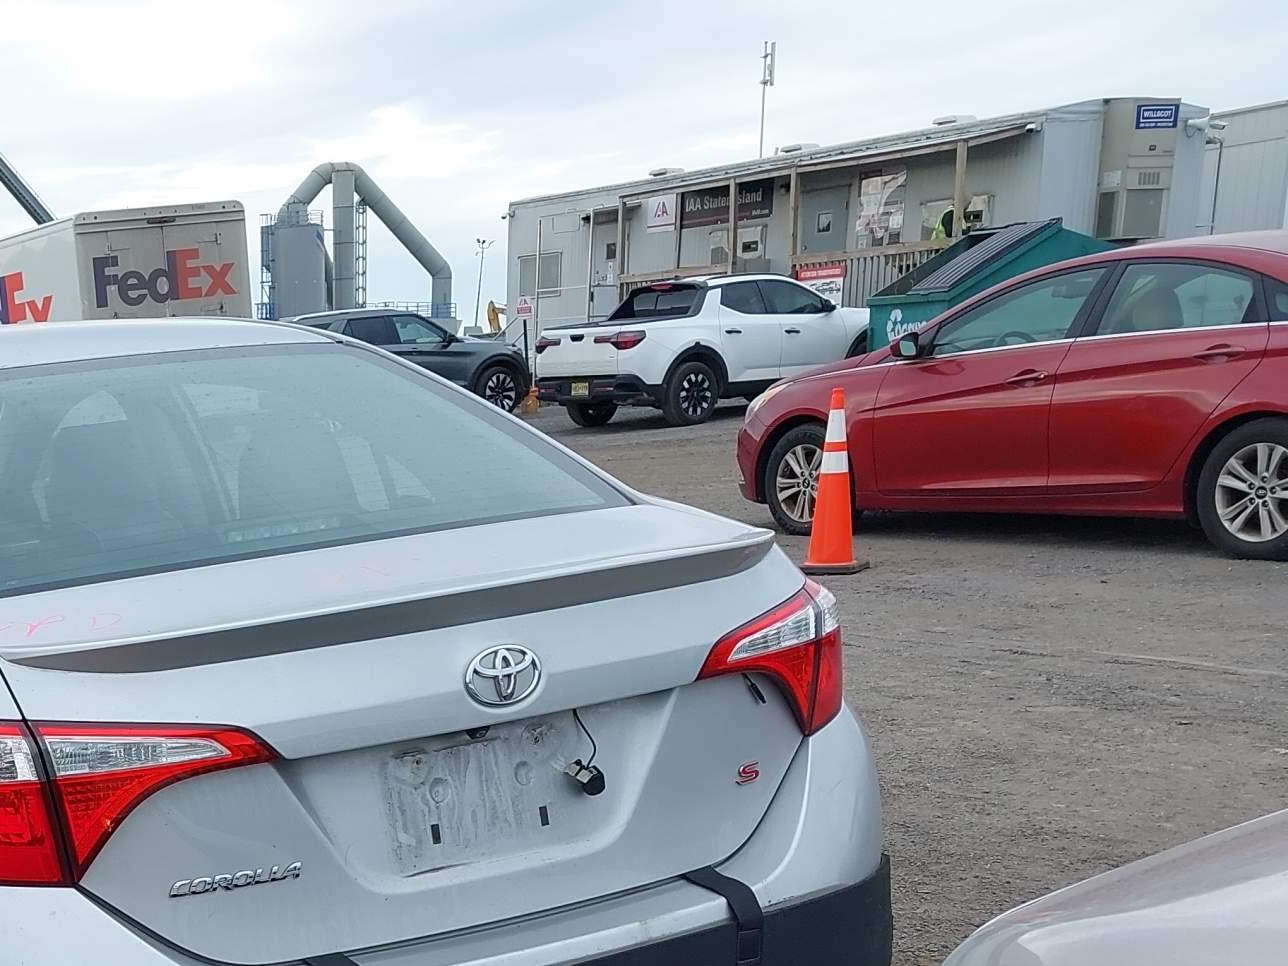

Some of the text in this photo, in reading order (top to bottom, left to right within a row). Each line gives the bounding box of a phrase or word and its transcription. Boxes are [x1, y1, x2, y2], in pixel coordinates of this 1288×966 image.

[1143, 110, 1172, 118] WILLSCOT
[685, 198, 702, 213] IAA
[736, 187, 763, 205] sland
[92, 248, 238, 309] FedEx
[737, 760, 760, 785] S
[169, 861, 302, 897] COROLLA
